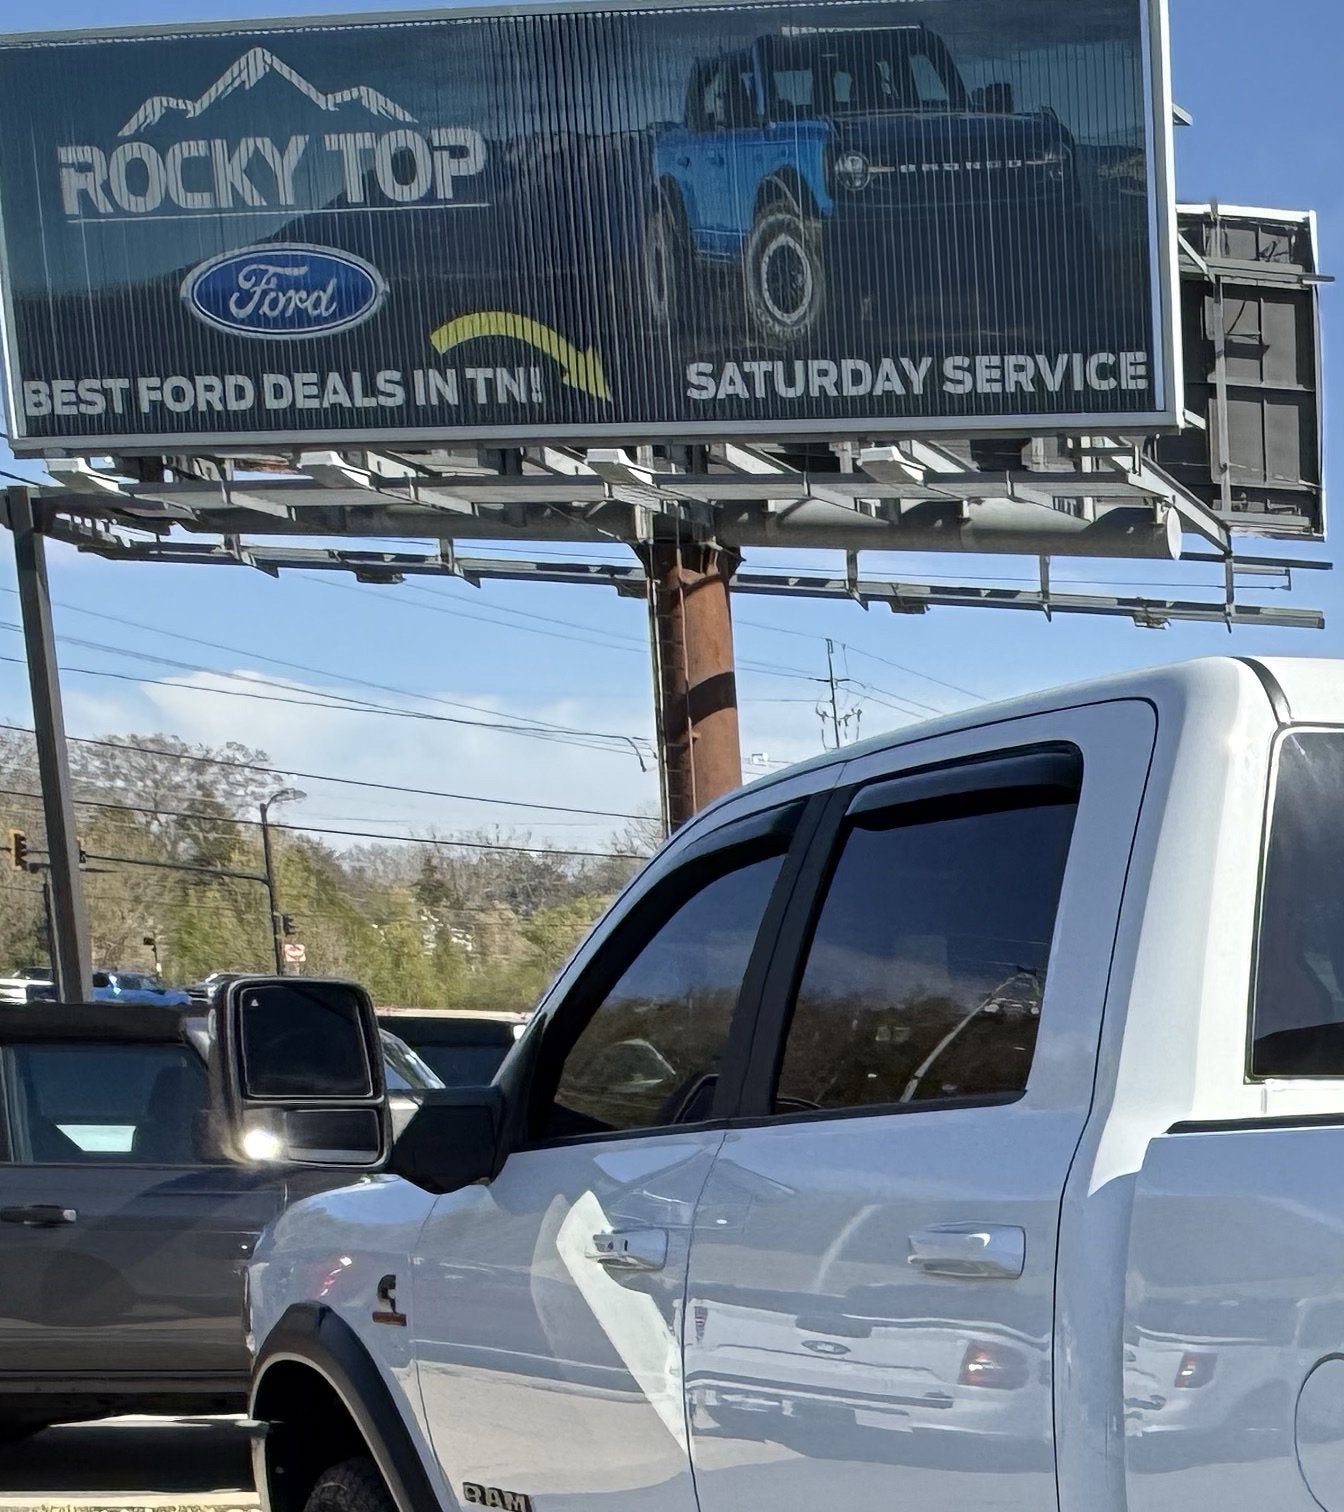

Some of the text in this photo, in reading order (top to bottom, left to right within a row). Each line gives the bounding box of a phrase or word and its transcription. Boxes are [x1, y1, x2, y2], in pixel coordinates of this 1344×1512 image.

[57, 127, 488, 217] ROCKY TOP
[228, 263, 338, 319] Ford
[22, 376, 130, 418] BEST
[137, 372, 256, 415] FORD
[263, 368, 406, 412] DEALS
[413, 367, 459, 406] IN
[685, 351, 1149, 404] SATURDAY SERVICE
